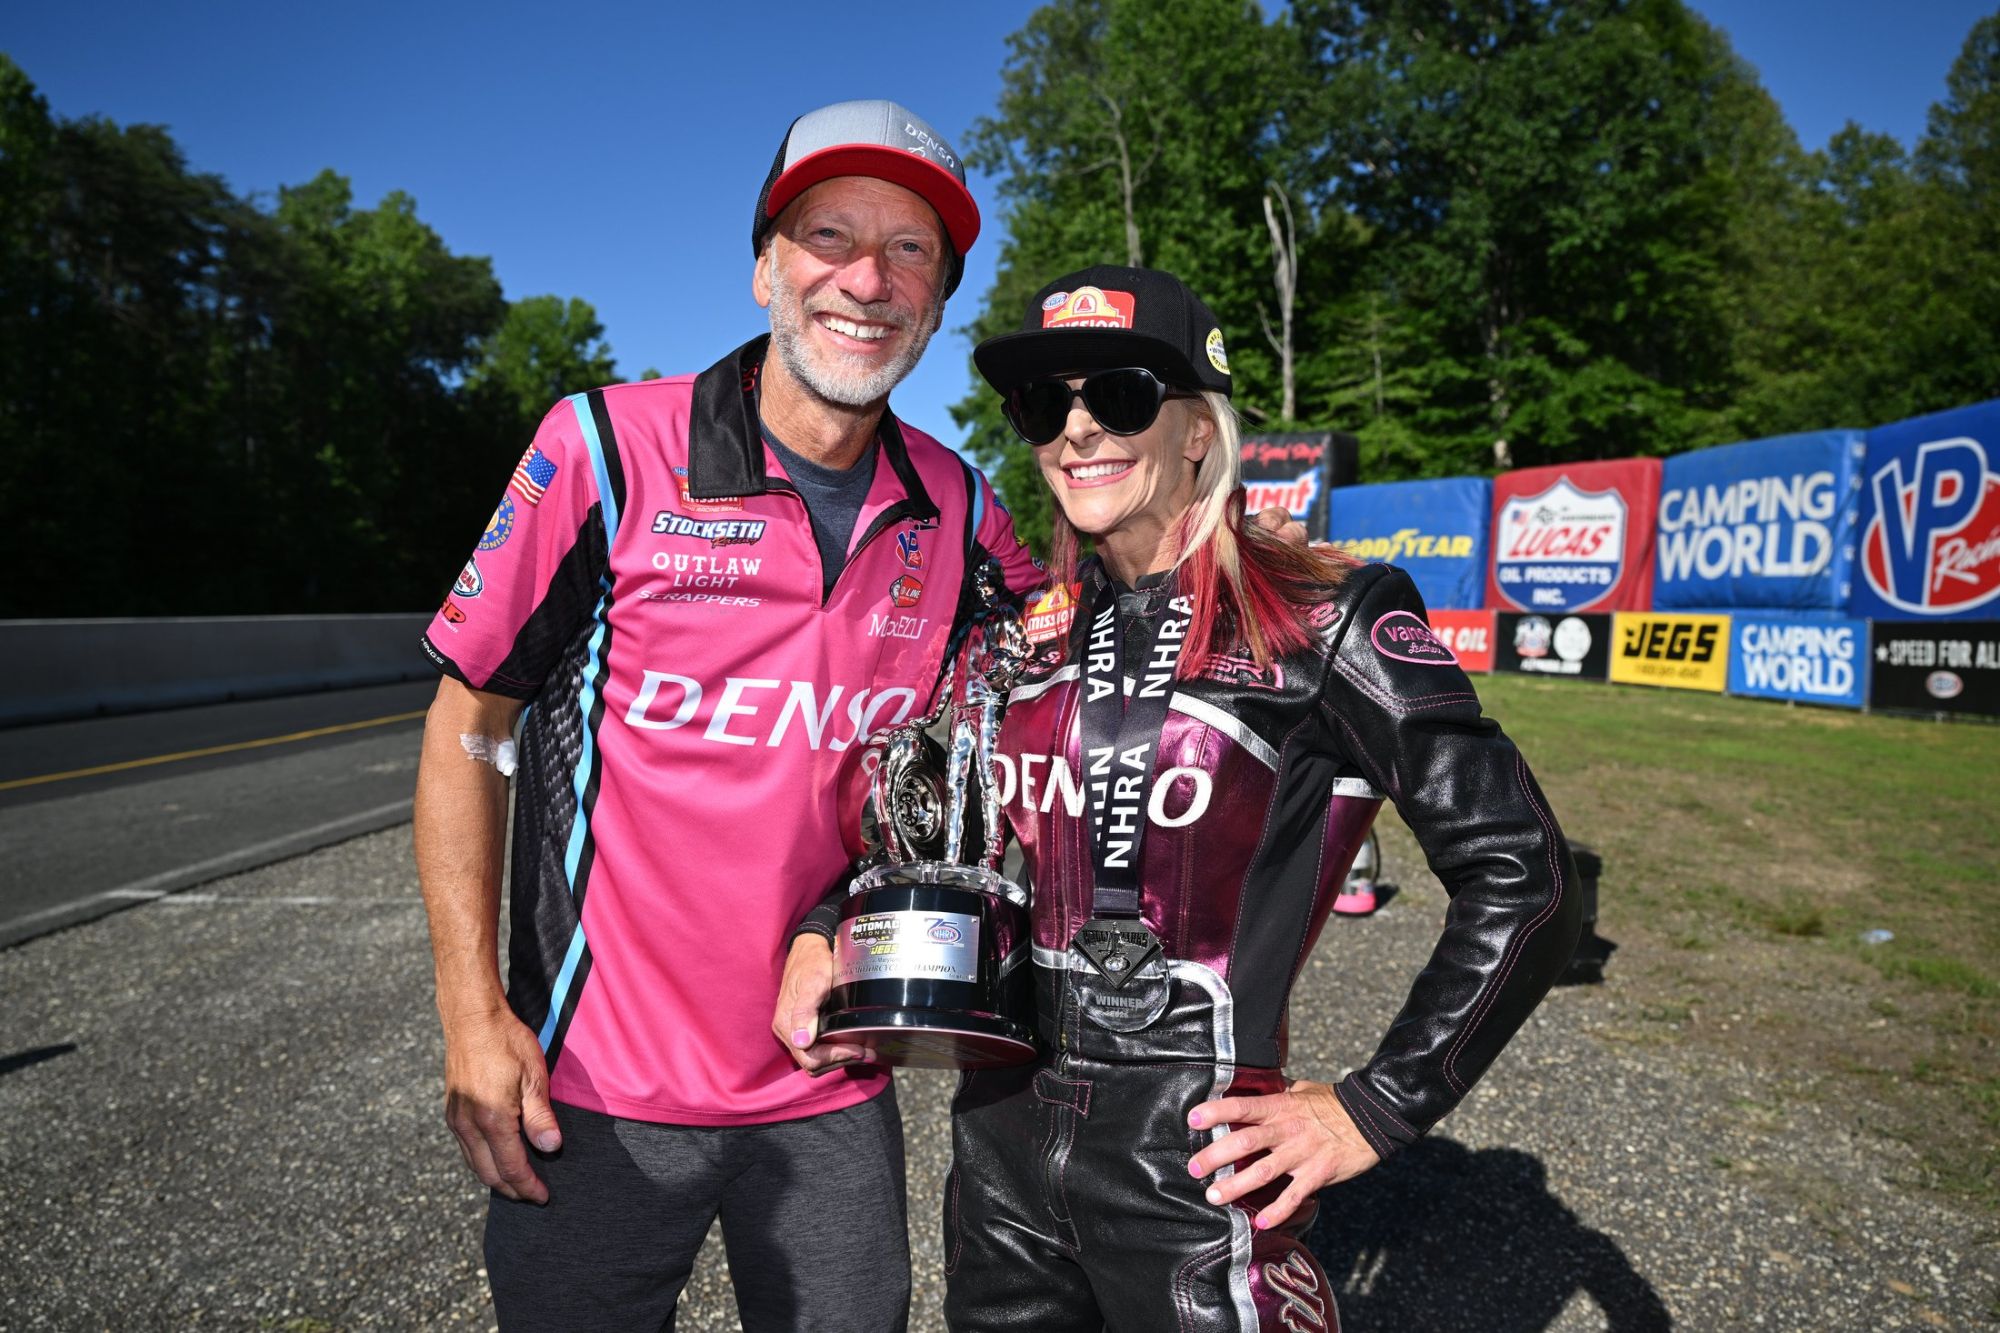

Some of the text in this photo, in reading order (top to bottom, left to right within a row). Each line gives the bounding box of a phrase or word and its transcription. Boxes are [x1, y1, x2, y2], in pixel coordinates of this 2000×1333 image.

[904, 123, 954, 168] DENSO
[1659, 471, 1836, 532] CAMPING
[653, 512, 765, 540] STOCKSETH
[1872, 437, 1988, 609] VP
[1508, 525, 1612, 558] LUCAS
[1658, 521, 1833, 582] WORLD
[652, 552, 762, 576] OUTLAW
[673, 574, 739, 588] LIGHT
[1499, 566, 1612, 585] OIL PRODUCTS
[637, 590, 761, 607] SCRAPPERS
[1087, 604, 1115, 703] NHRA
[1139, 594, 1195, 698] NHRA
[1456, 627, 1487, 651] OIL
[1623, 623, 1719, 662] JEGS
[1741, 624, 1854, 659] CAMPING
[1889, 639, 1936, 667] SPEED
[1938, 639, 1972, 668] FOR
[1741, 652, 1854, 696] WORLD
[624, 669, 917, 752] DENSO
[992, 752, 1213, 828] DENO
[1104, 742, 1151, 868] NHRA
[850, 918, 900, 934] POTOMAC
[934, 929, 954, 941] NHRA
[870, 944, 899, 955] JEGS
[1096, 994, 1144, 1009] WINNER
